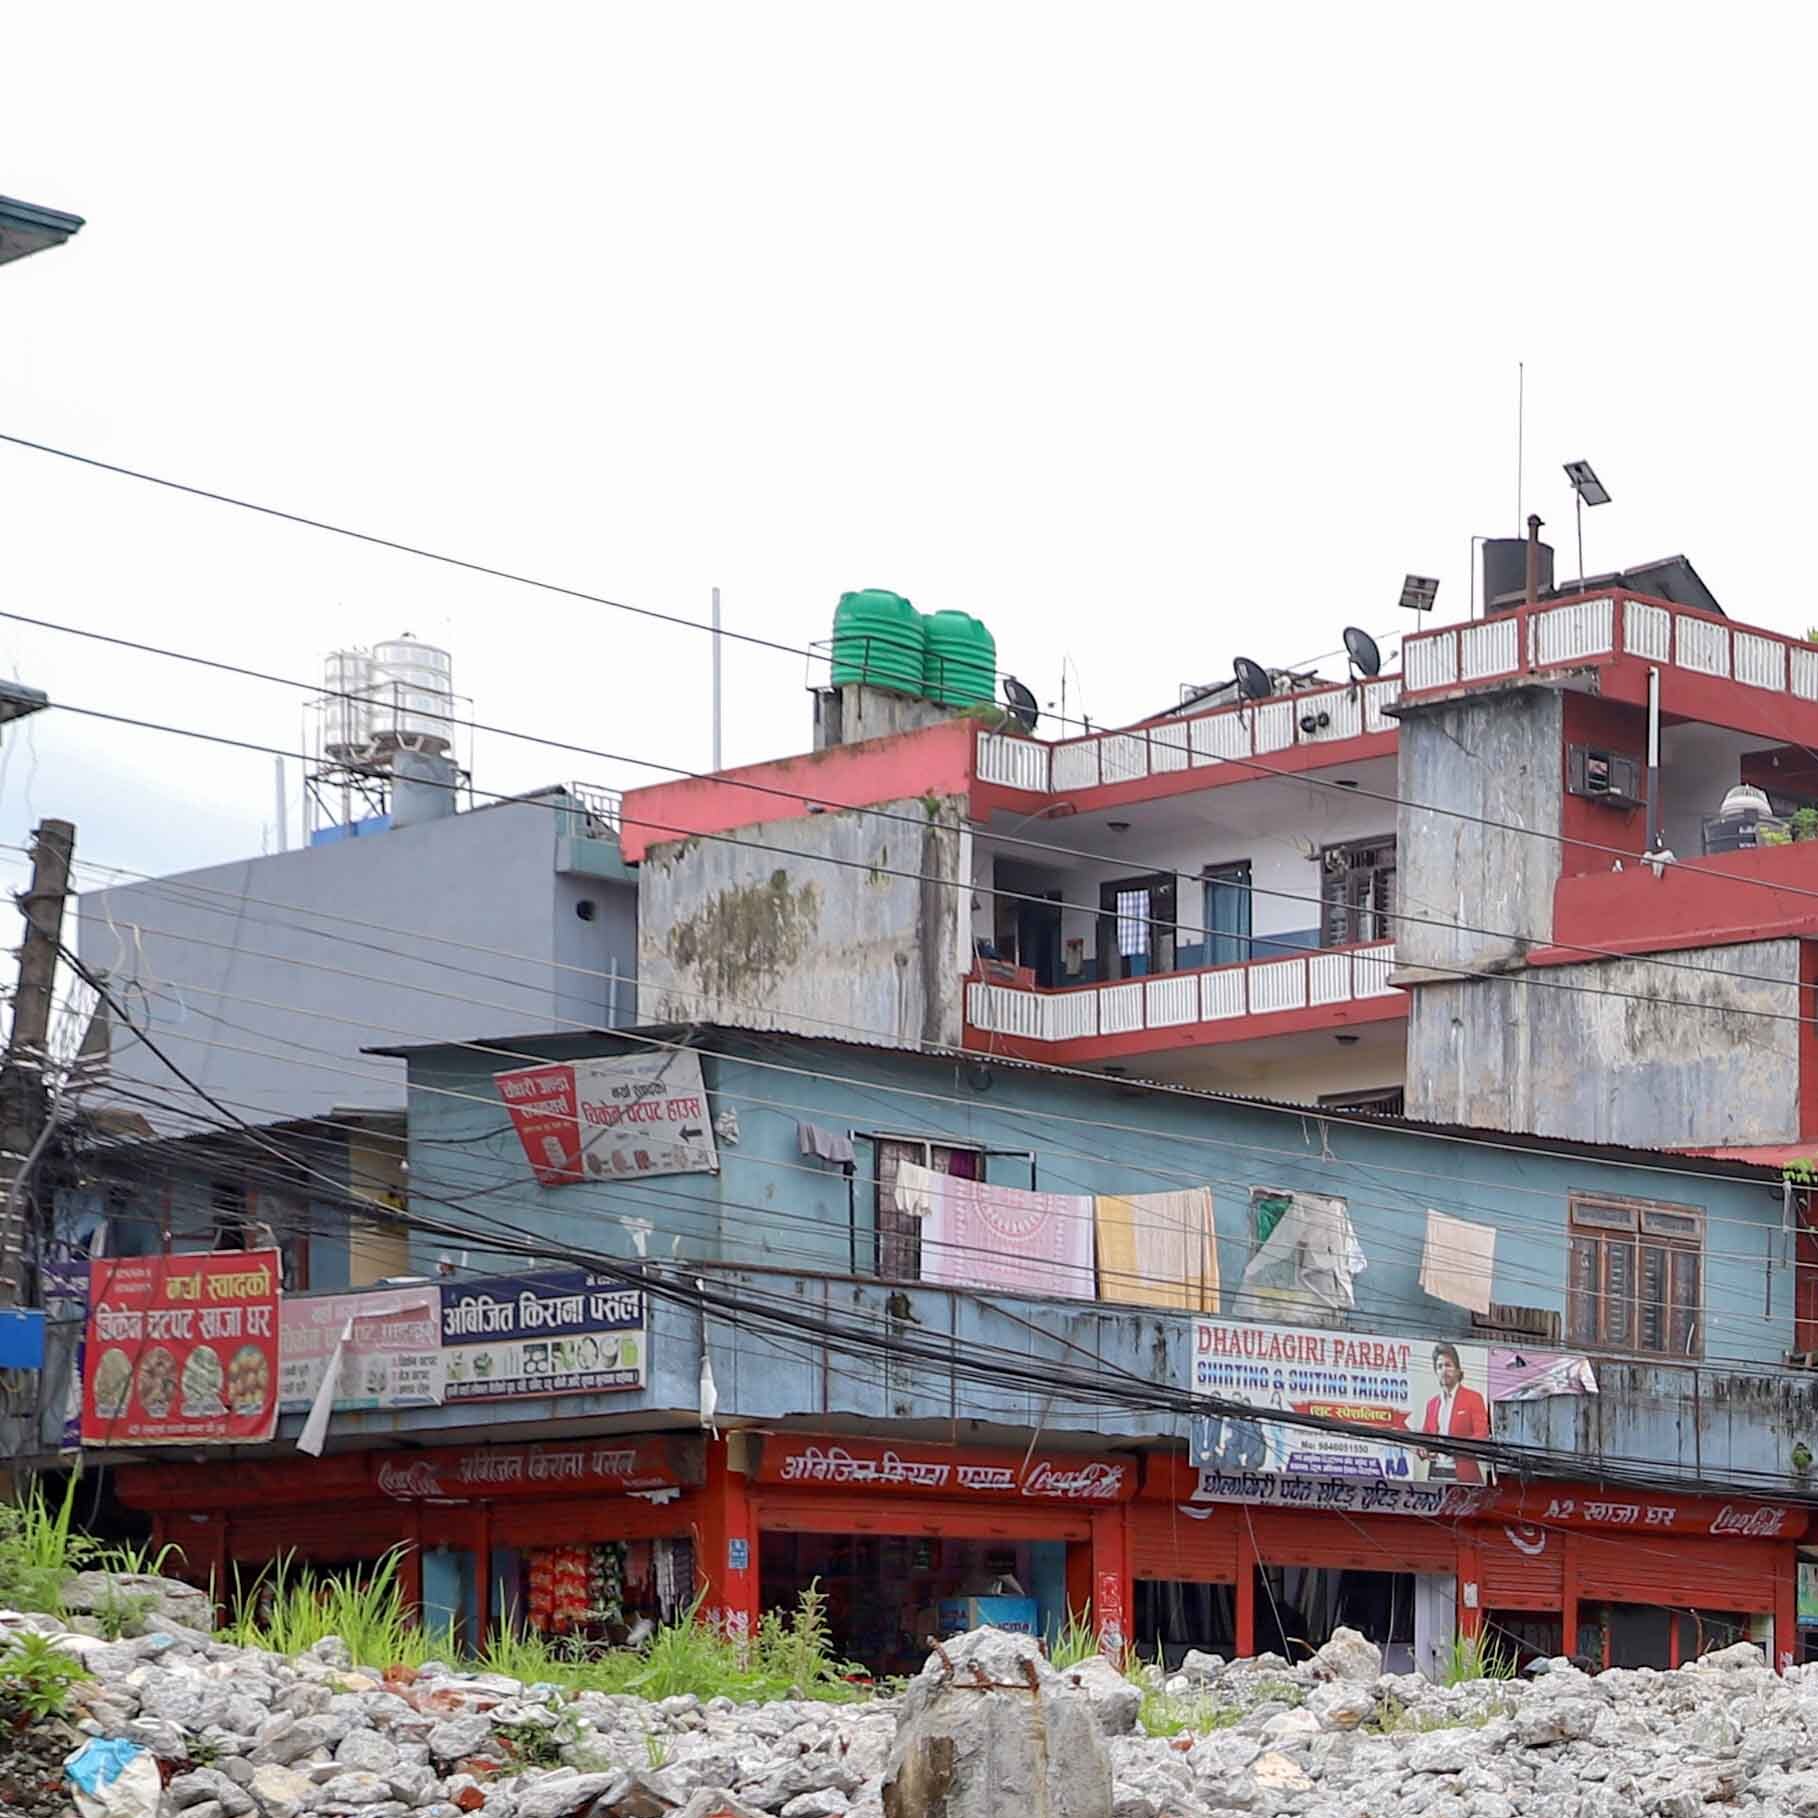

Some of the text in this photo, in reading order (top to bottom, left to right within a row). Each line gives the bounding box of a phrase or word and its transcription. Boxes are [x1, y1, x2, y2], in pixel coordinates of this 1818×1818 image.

[207, 1264, 272, 1300] स्वादको
[199, 1306, 243, 1340] खाजा
[246, 1305, 273, 1338] घर
[518, 1290, 586, 1330] किराना
[590, 1290, 641, 1323] पसल
[1198, 1325, 1410, 1371] DHAULAGIRI PARBAT
[1197, 1360, 1269, 1390] SHIRTING
[1288, 1369, 1348, 1397] SUITING
[1350, 1374, 1409, 1402] TAILORS
[1583, 1501, 1640, 1525] खाजा
[1644, 1505, 1677, 1525] घर
